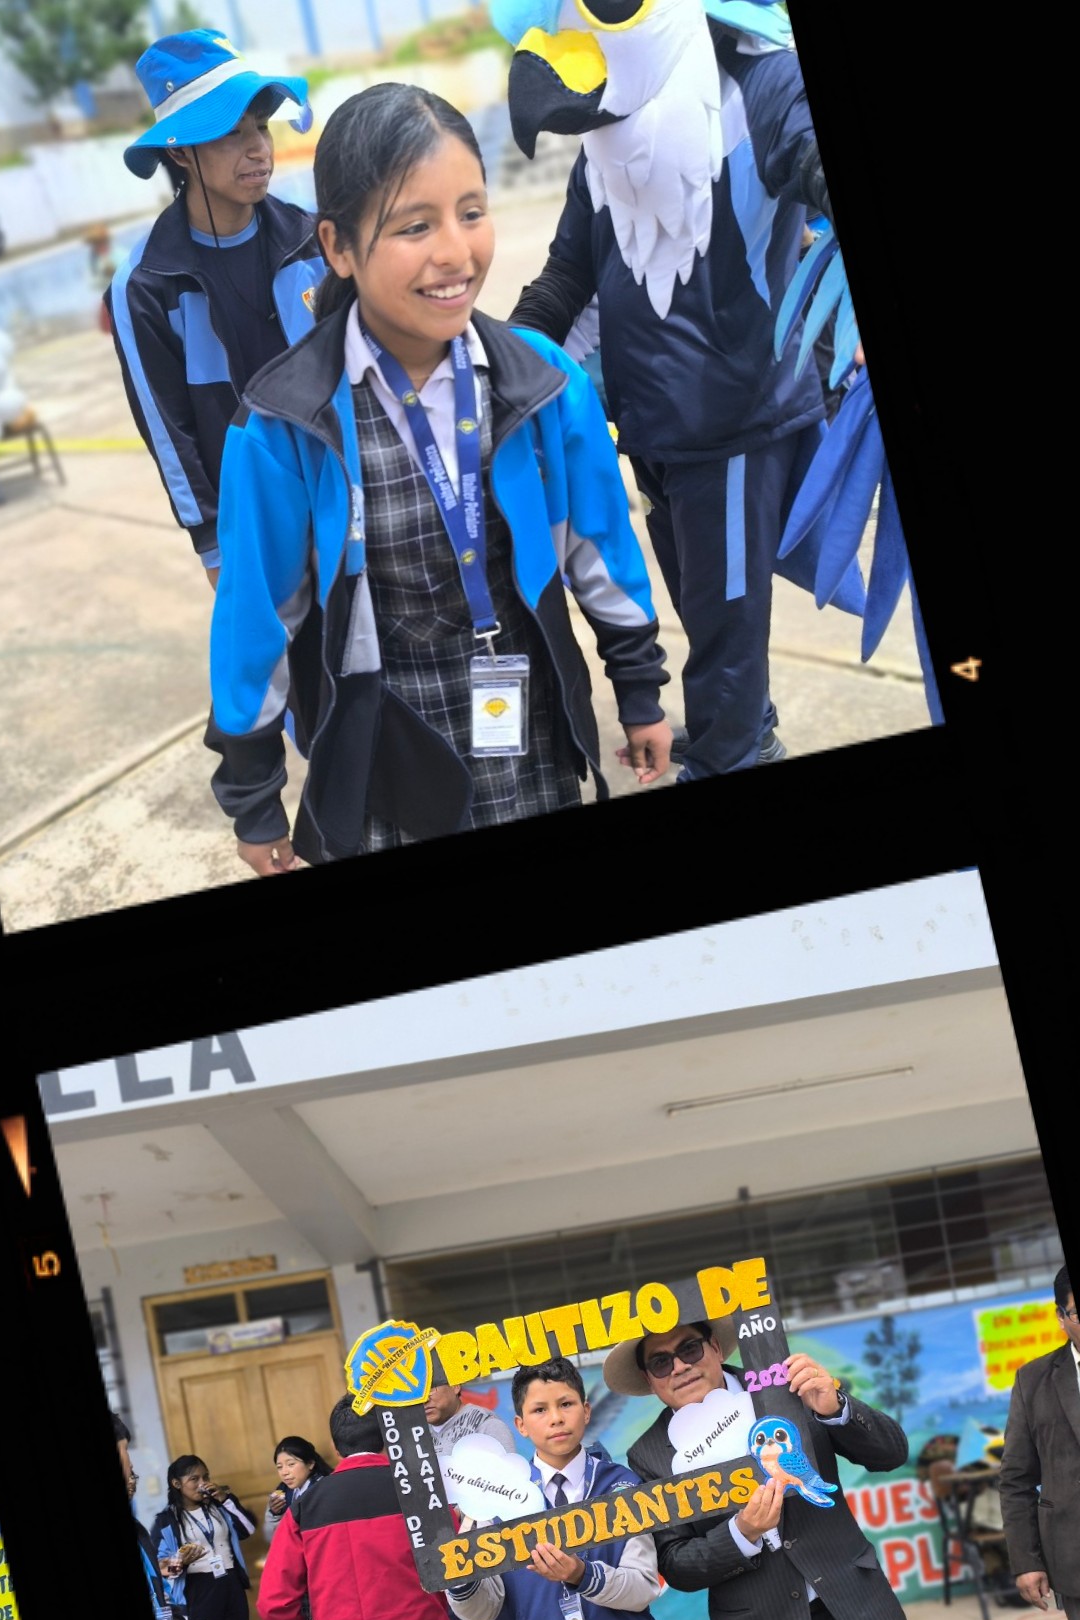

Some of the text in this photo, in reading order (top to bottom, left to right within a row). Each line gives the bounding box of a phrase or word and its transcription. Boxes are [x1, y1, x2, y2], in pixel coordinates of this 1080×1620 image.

[436, 1256, 772, 1387] BAUTIZO DE
[737, 1314, 777, 1341] AÑO
[359, 1368, 385, 1399] INTEGRADA
[743, 1362, 790, 1393] 202
[683, 1408, 742, 1464] Soy padrino
[381, 1410, 426, 1549] BODAS DE
[411, 1425, 443, 1510] PLATA
[443, 1466, 465, 1484] Soy
[438, 1466, 765, 1581] ESTUDIANTES
